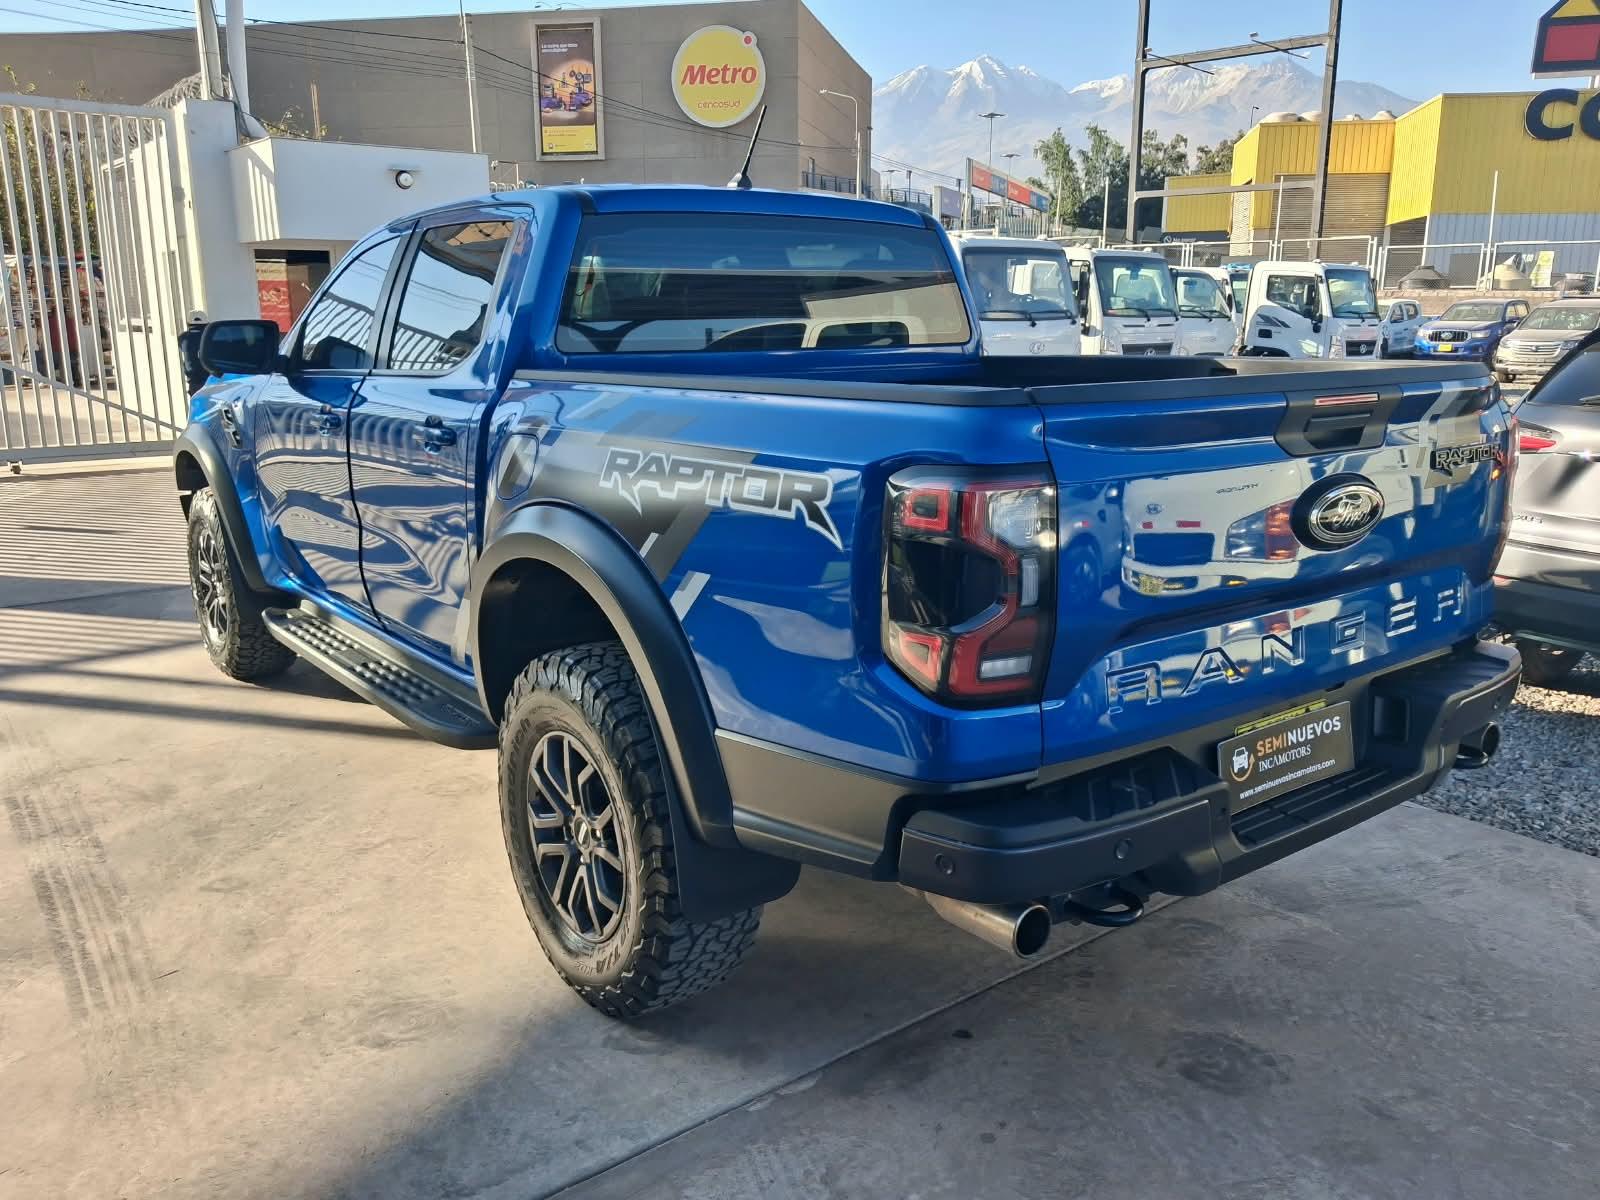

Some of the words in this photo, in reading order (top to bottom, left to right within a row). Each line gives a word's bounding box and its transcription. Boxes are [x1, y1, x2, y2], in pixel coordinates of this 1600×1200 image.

[681, 64, 758, 85] Metro
[697, 100, 741, 109] cencosud
[1431, 443, 1502, 475] RAPTOR
[599, 447, 843, 551] RAPTOR
[1105, 577, 1464, 714] RANGER
[1256, 716, 1342, 757] SEMINUEVOS
[1259, 744, 1312, 772] INCAMOTORS
[1239, 758, 1336, 800] www.seminuevosincamotors.com
